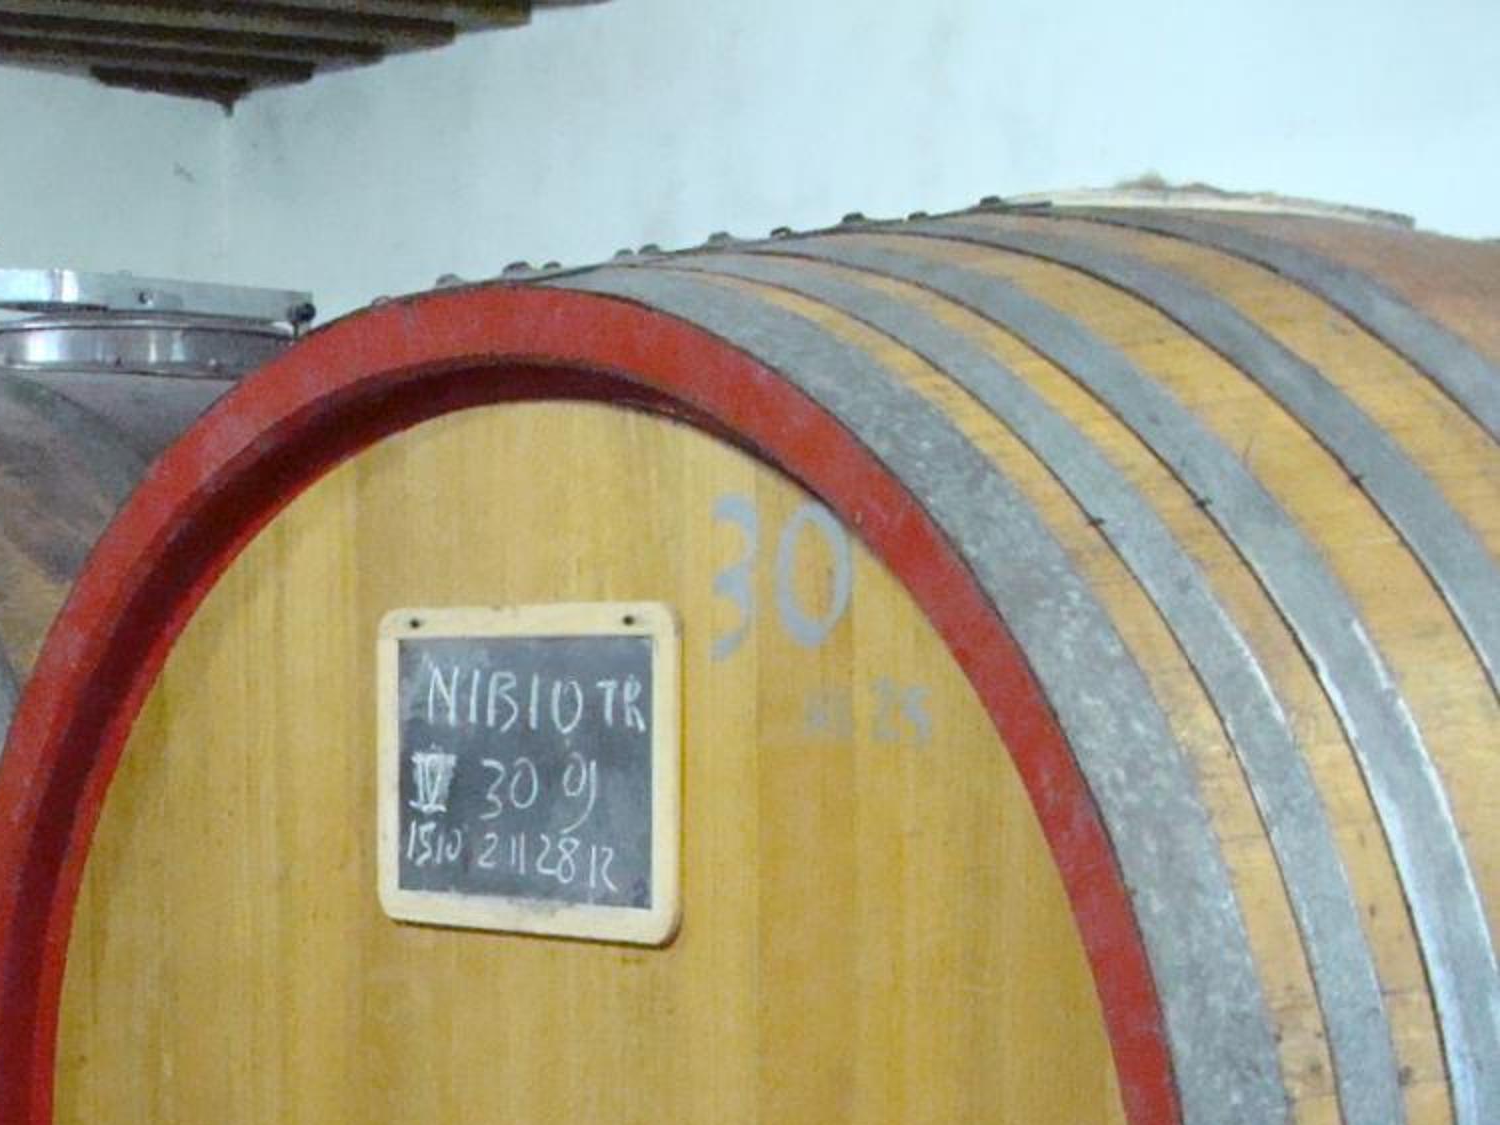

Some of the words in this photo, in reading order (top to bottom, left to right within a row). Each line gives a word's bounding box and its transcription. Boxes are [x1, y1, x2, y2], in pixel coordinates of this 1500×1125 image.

[709, 491, 855, 664] 30
[426, 664, 584, 734] NIBIO
[596, 672, 647, 733] TR
[479, 755, 539, 820] 30
